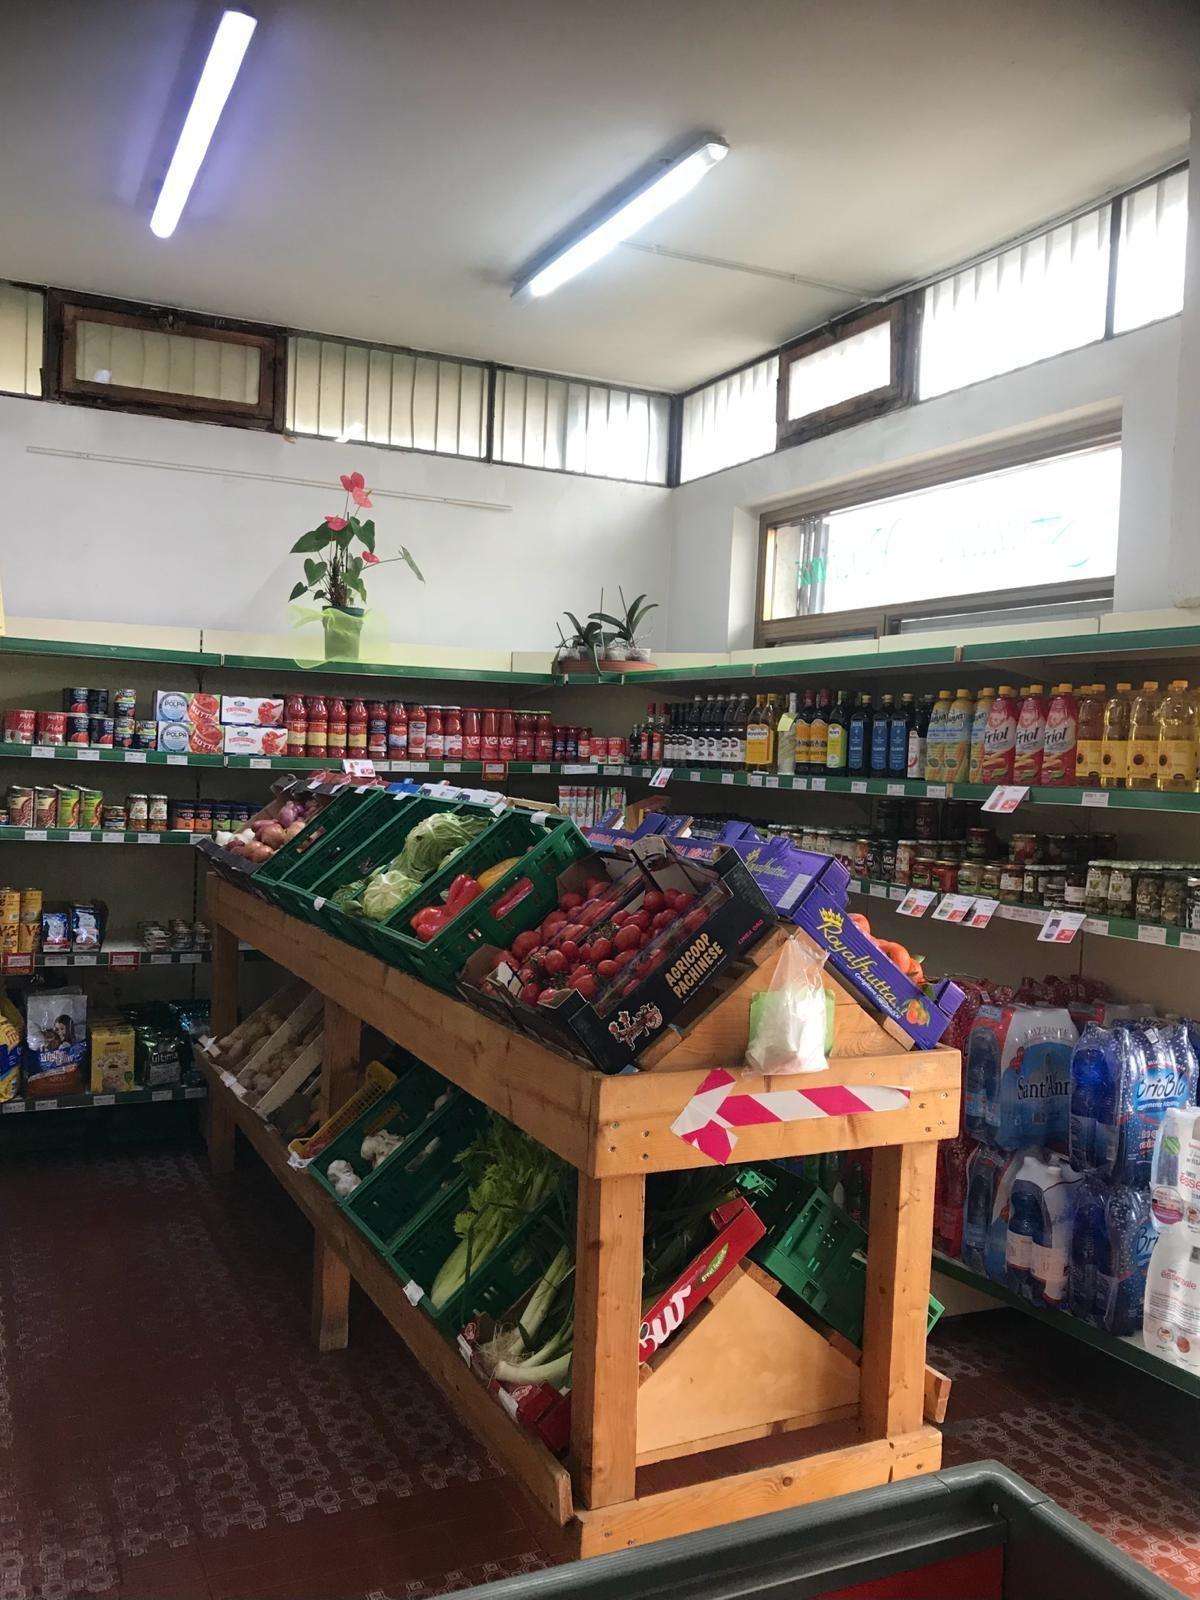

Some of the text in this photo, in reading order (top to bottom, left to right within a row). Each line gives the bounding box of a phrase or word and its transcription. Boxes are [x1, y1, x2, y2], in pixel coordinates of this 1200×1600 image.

[984, 727, 1009, 744] Friol
[1016, 727, 1040, 743] Friol
[664, 932, 711, 988] AGRICOOP
[672, 941, 724, 999] PACHINESE
[816, 922, 899, 1008] Royalfrutta
[1136, 1072, 1186, 1099] BrioBlu
